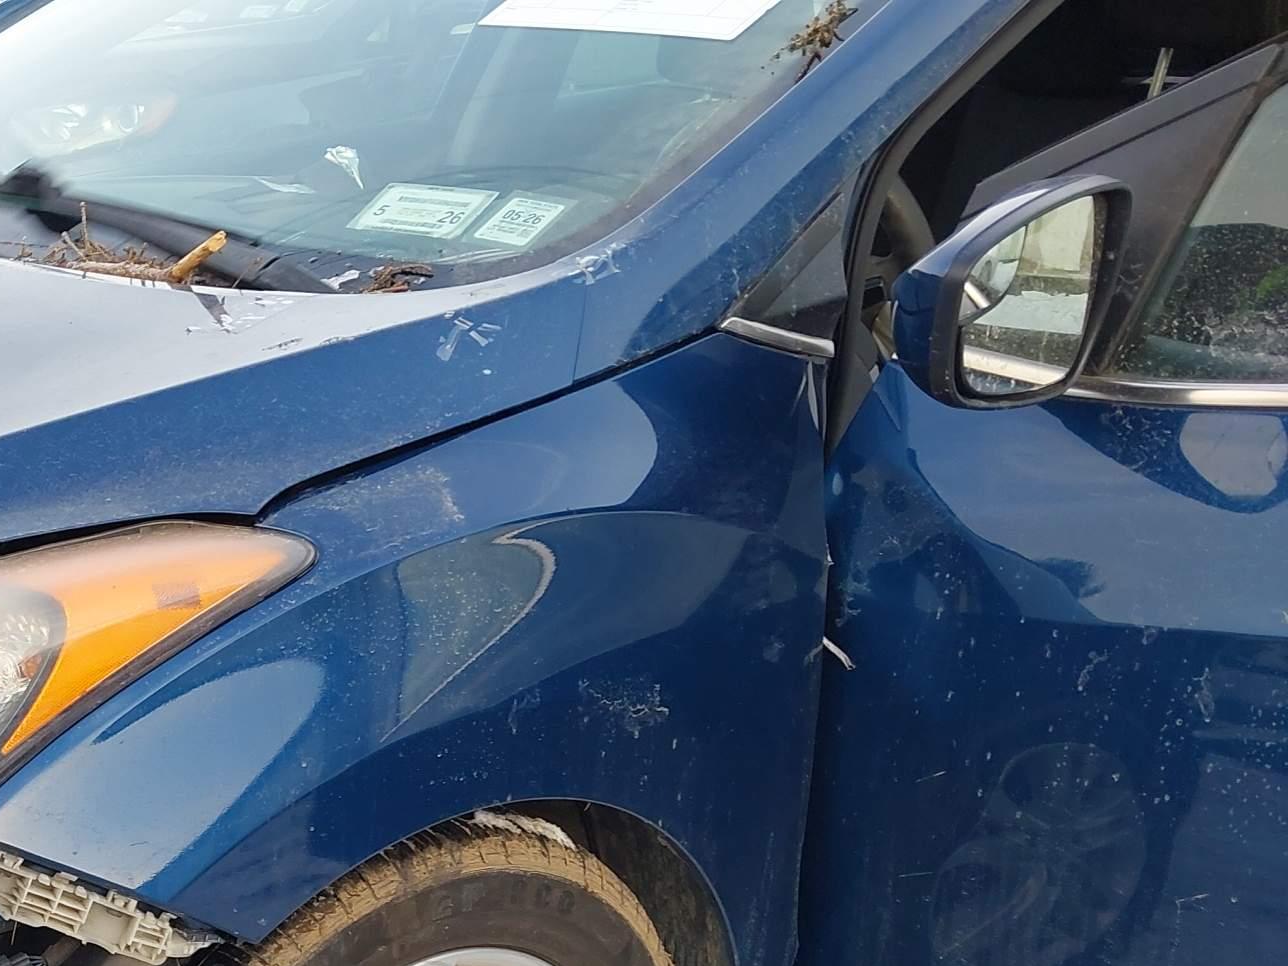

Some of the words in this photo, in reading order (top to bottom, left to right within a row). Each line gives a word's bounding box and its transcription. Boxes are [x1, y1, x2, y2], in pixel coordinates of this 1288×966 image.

[373, 204, 391, 216] 5
[437, 210, 465, 225] 26
[522, 213, 546, 225] 26
